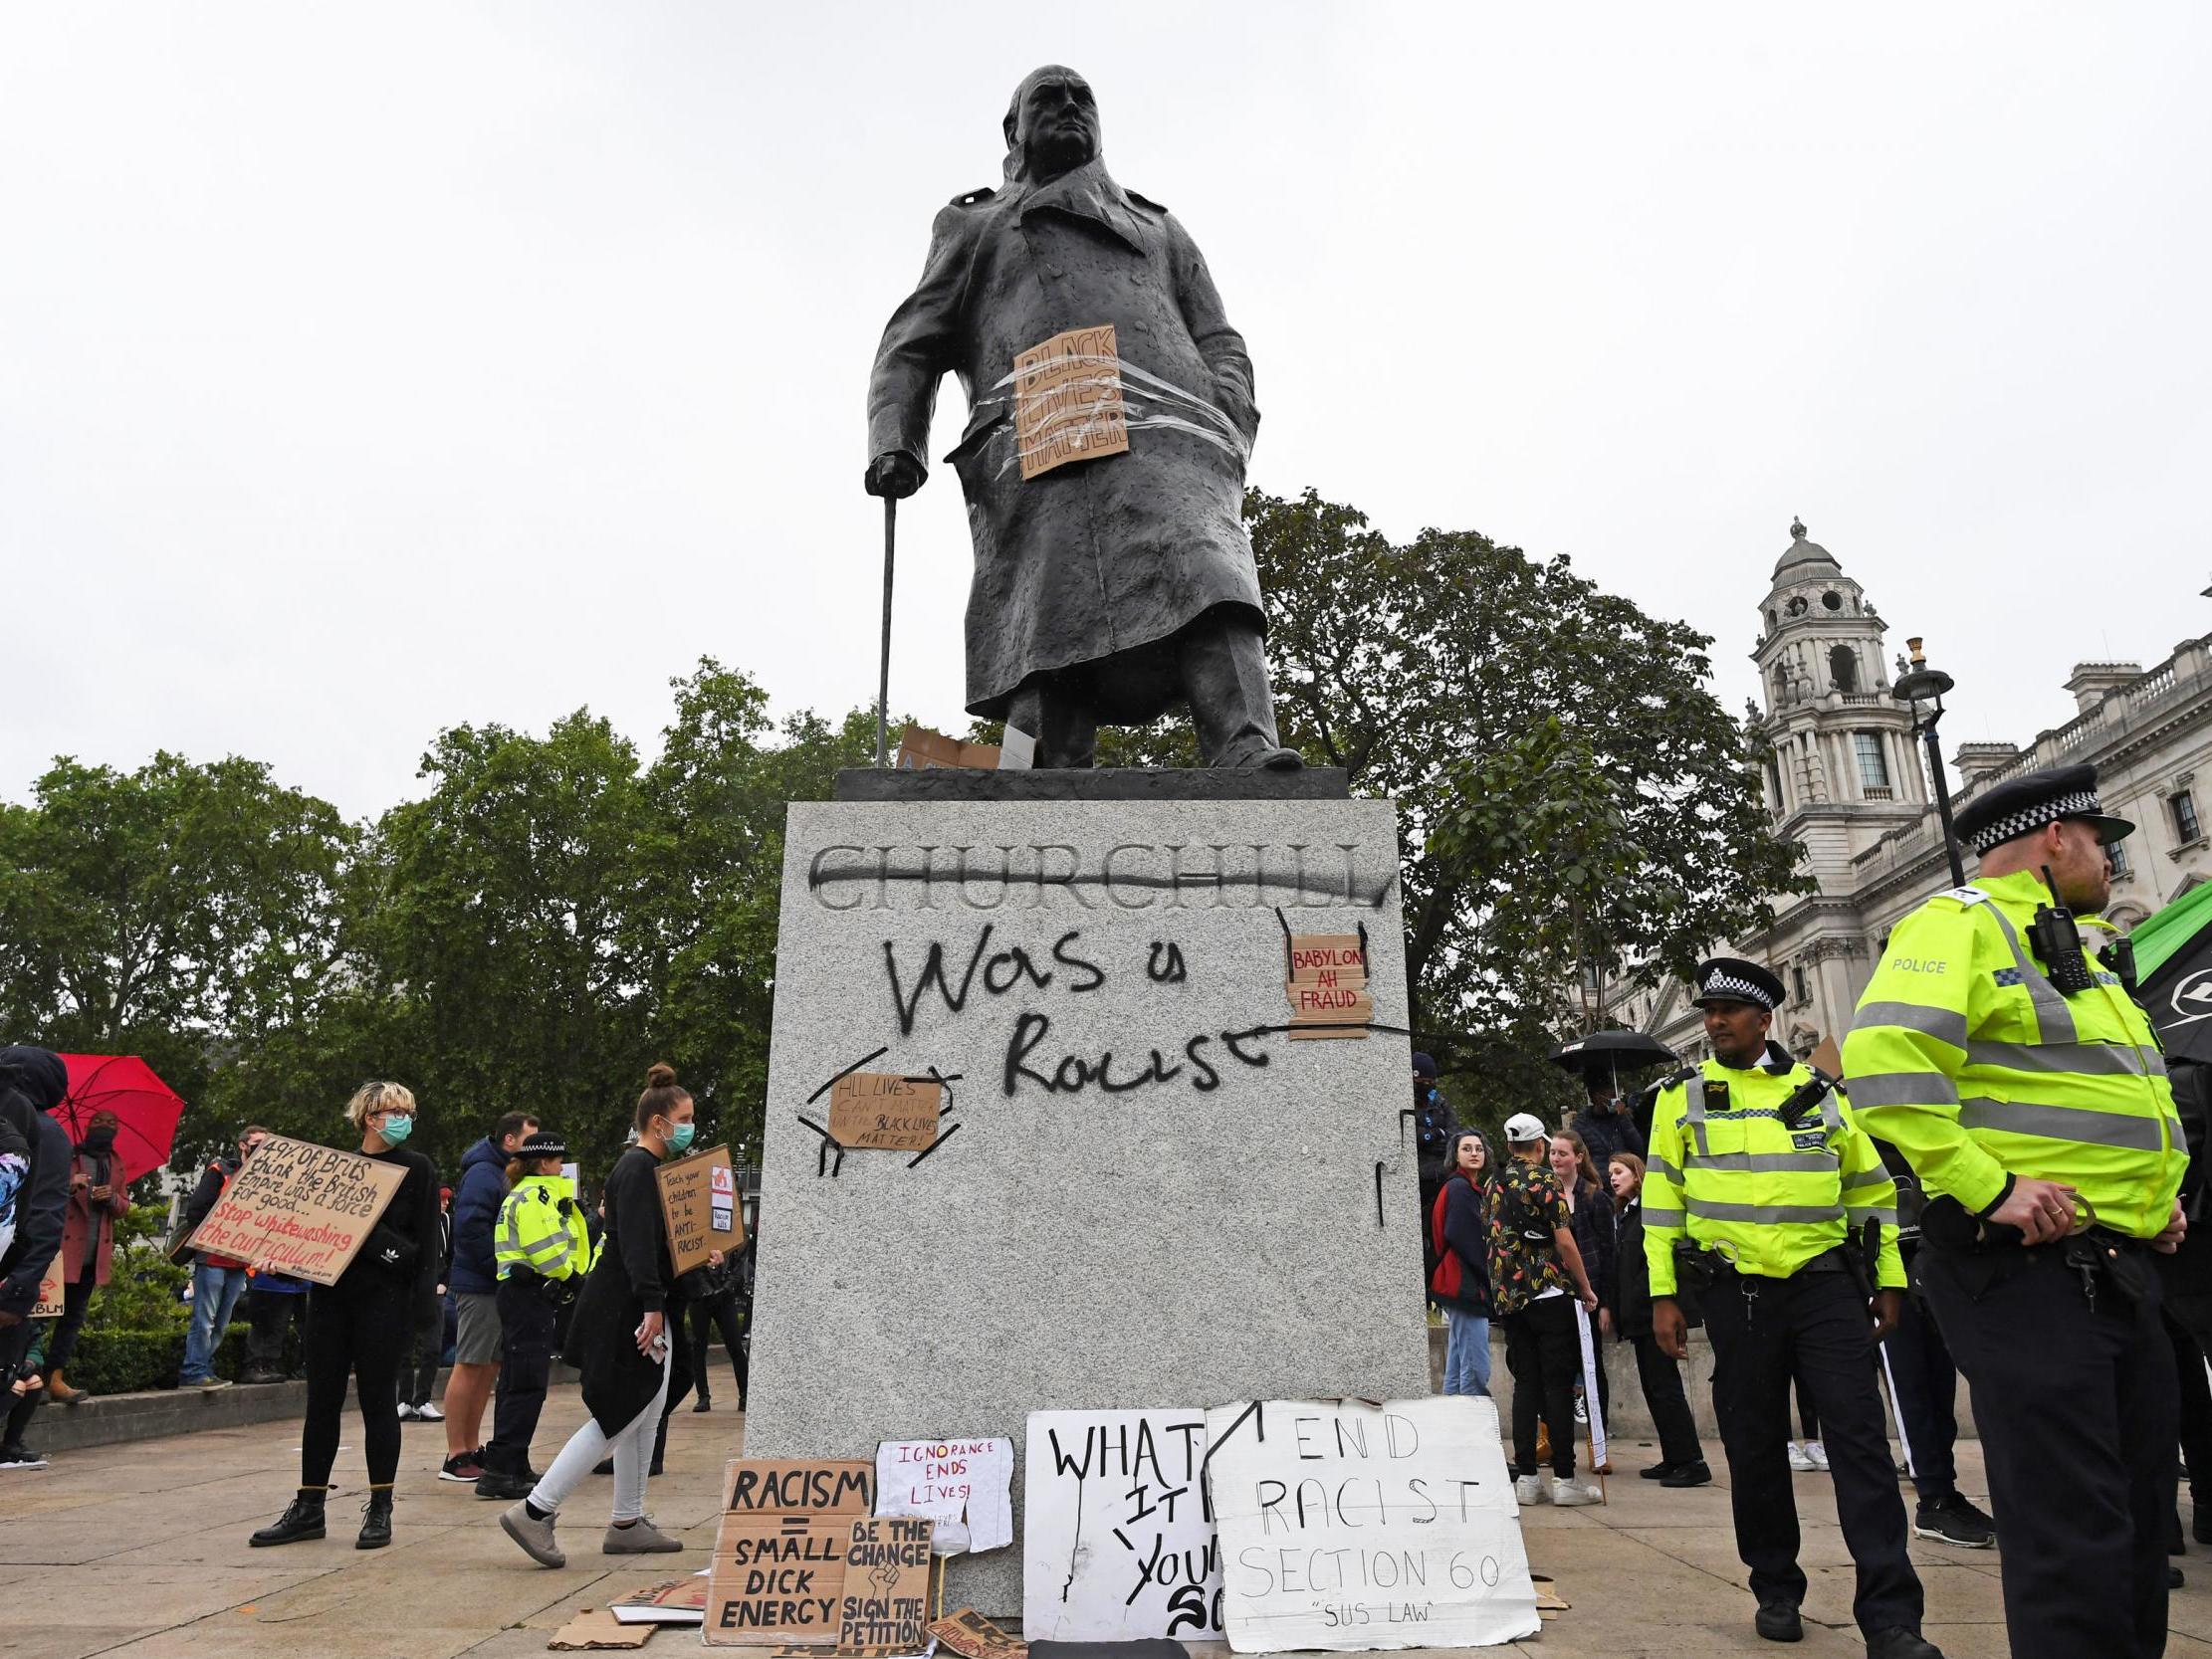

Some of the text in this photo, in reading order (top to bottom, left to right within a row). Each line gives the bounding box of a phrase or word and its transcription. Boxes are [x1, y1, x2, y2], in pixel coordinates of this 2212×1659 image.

[1021, 328, 1117, 392] BLACK
[1021, 369, 1121, 433] LIVES
[1023, 410, 1128, 471] MATTER
[808, 844, 1382, 911] CHURCHILL
[1293, 949, 1363, 969] BABYLON
[1892, 958, 1946, 974] POLICE
[883, 925, 1106, 1035] Was
[1318, 971, 1338, 987] AH
[1301, 990, 1357, 1010] FRAUD
[839, 1075, 916, 1097] ALL LIVES
[874, 1115, 910, 1132] BLACK
[912, 1117, 937, 1135] LIVES
[856, 1133, 923, 1146] MATTER!
[251, 1156, 294, 1178] think
[298, 1168, 324, 1190] the
[664, 1172, 685, 1187] Teach
[230, 1186, 259, 1202] for
[285, 1184, 314, 1201] was
[314, 1194, 327, 1207] a
[327, 1196, 373, 1218] force
[668, 1189, 697, 1204] children
[685, 1203, 694, 1216] be
[199, 1222, 231, 1244] the
[255, 1214, 352, 1251] whitewashing
[1295, 1414, 1419, 1459] END
[898, 1442, 994, 1463] IGNORANCE
[1048, 1417, 1205, 1490] WHAT
[926, 1459, 968, 1480] ENDS
[730, 1470, 869, 1510] RACISM
[911, 1484, 971, 1504] LIVES!
[1125, 1485, 1189, 1525] IT
[1256, 1478, 1479, 1536] RACIST
[852, 1520, 931, 1543] BE THE
[735, 1538, 840, 1566] SMALL
[848, 1544, 929, 1567] CHANGE
[745, 1569, 815, 1594] DICK
[1126, 1533, 1217, 1605] YOU
[1239, 1548, 1499, 1597] SECTION 60
[720, 1597, 836, 1628] ENERGY
[842, 1596, 924, 1621] SIGN THE
[1312, 1600, 1434, 1627] "SUS LAW"
[840, 1620, 925, 1645] PETITION
